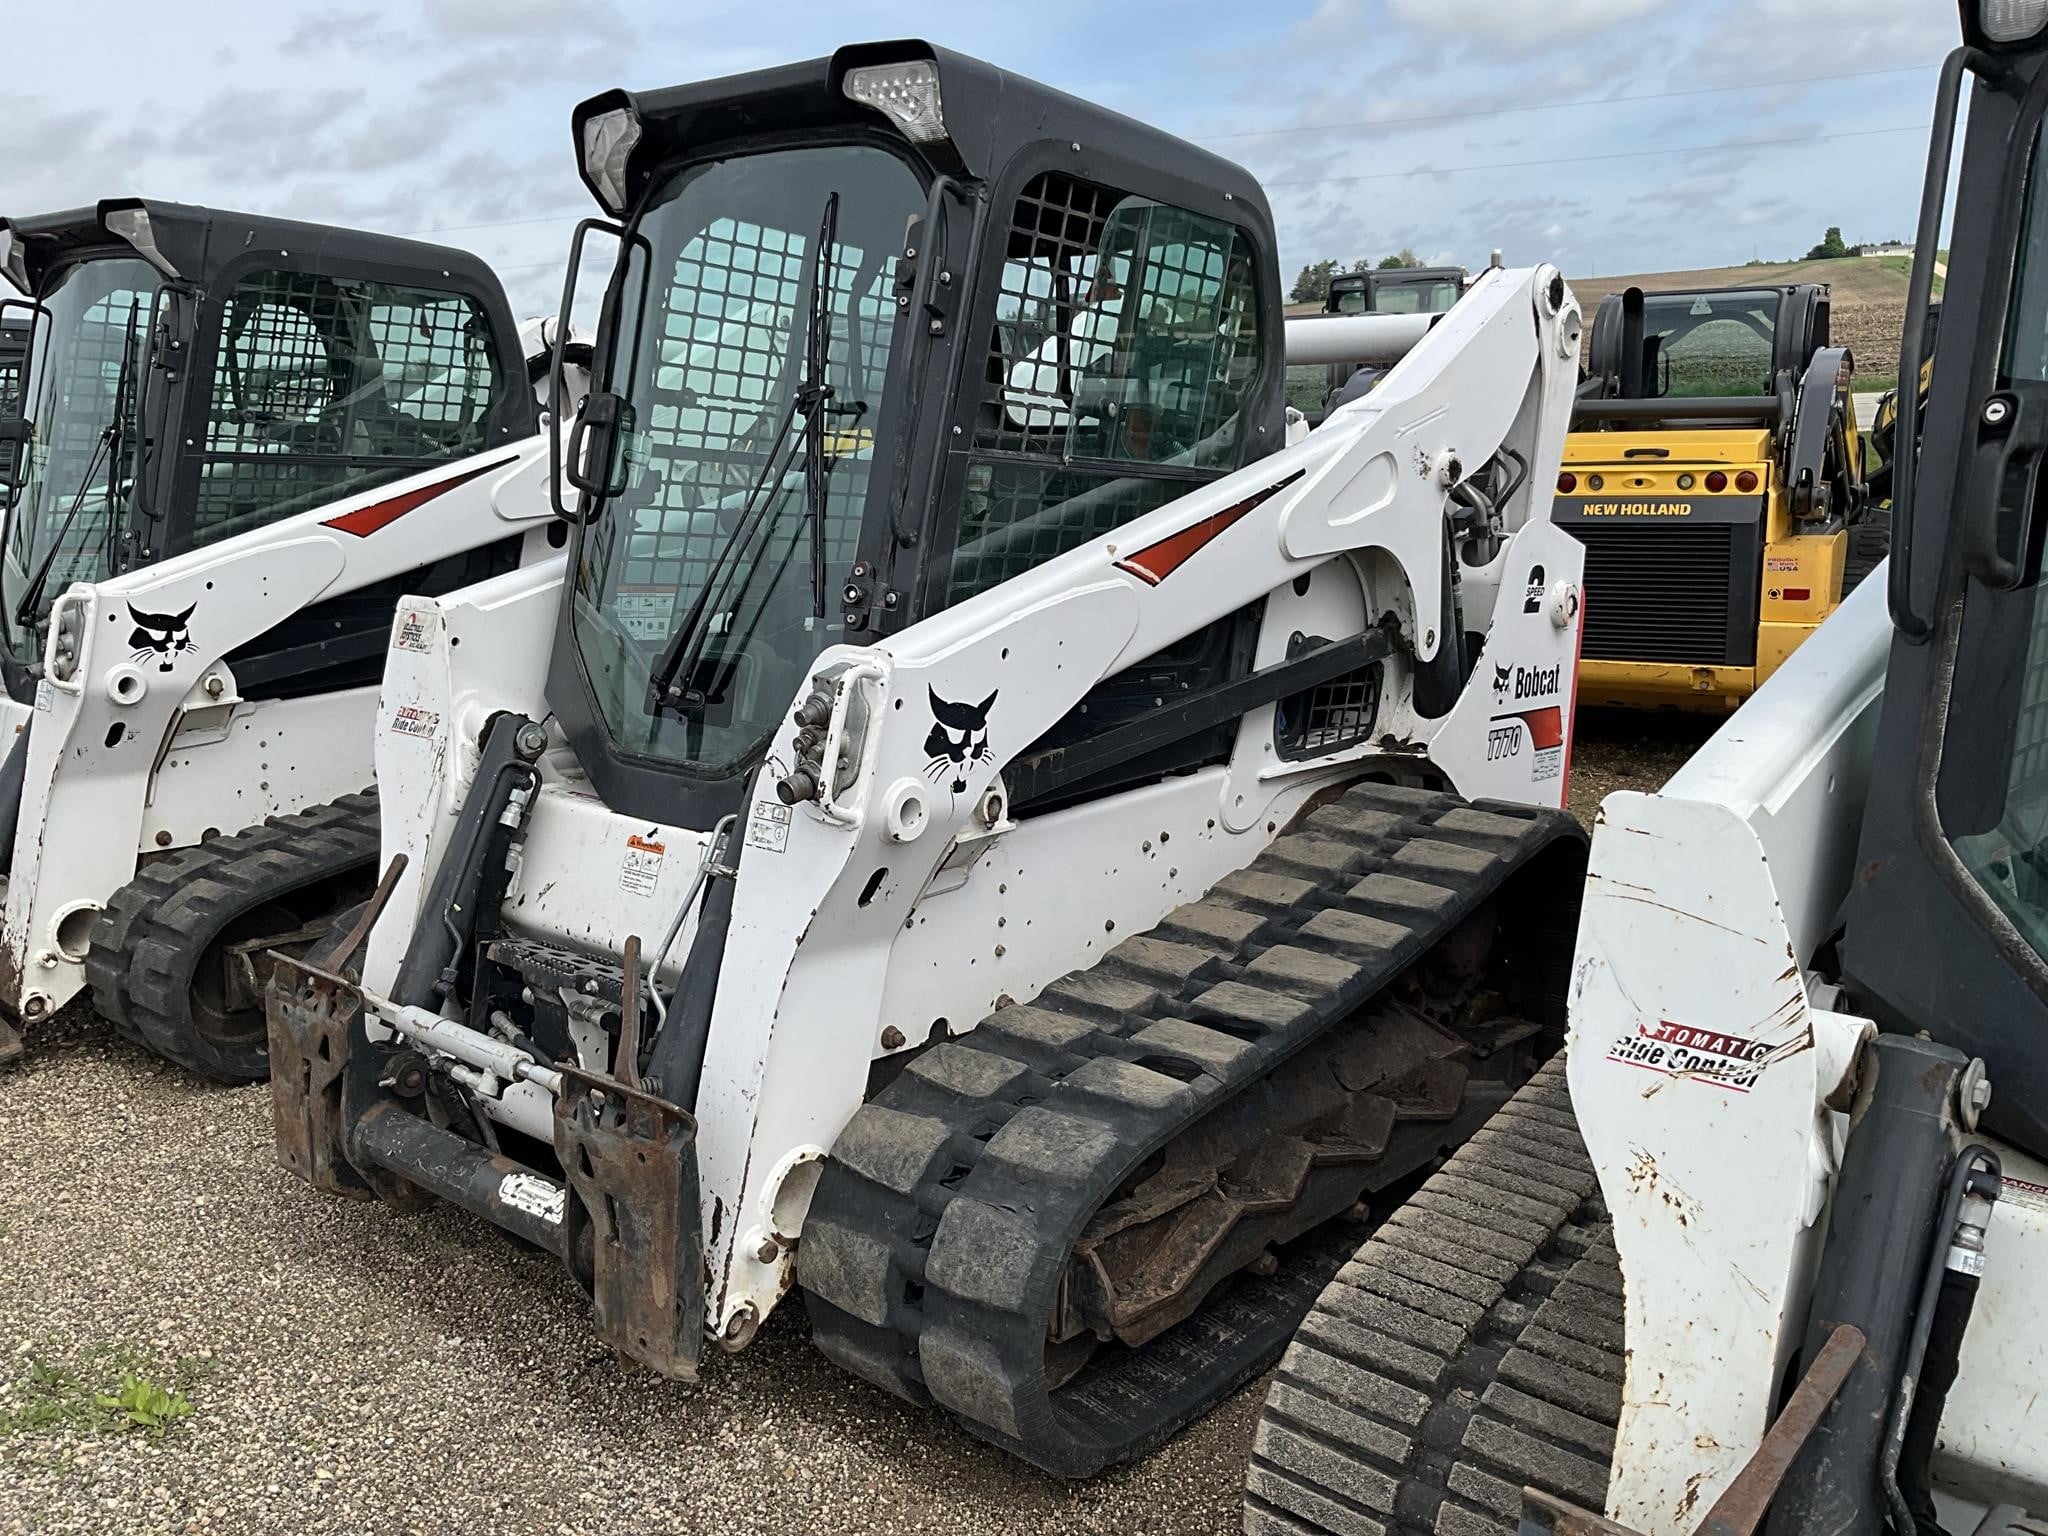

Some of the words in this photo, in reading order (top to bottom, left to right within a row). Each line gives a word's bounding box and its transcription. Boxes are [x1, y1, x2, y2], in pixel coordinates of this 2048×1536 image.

[1583, 503, 1618, 516] NEW
[1620, 503, 1691, 516] HOLLAND
[1523, 565, 1546, 614] 2
[1526, 586, 1545, 597] SPEED
[1514, 663, 1560, 700] Bobcat
[392, 717, 408, 731] Ride
[1487, 725, 1522, 762] T770
[1650, 1023, 1768, 1061] TOMATIC
